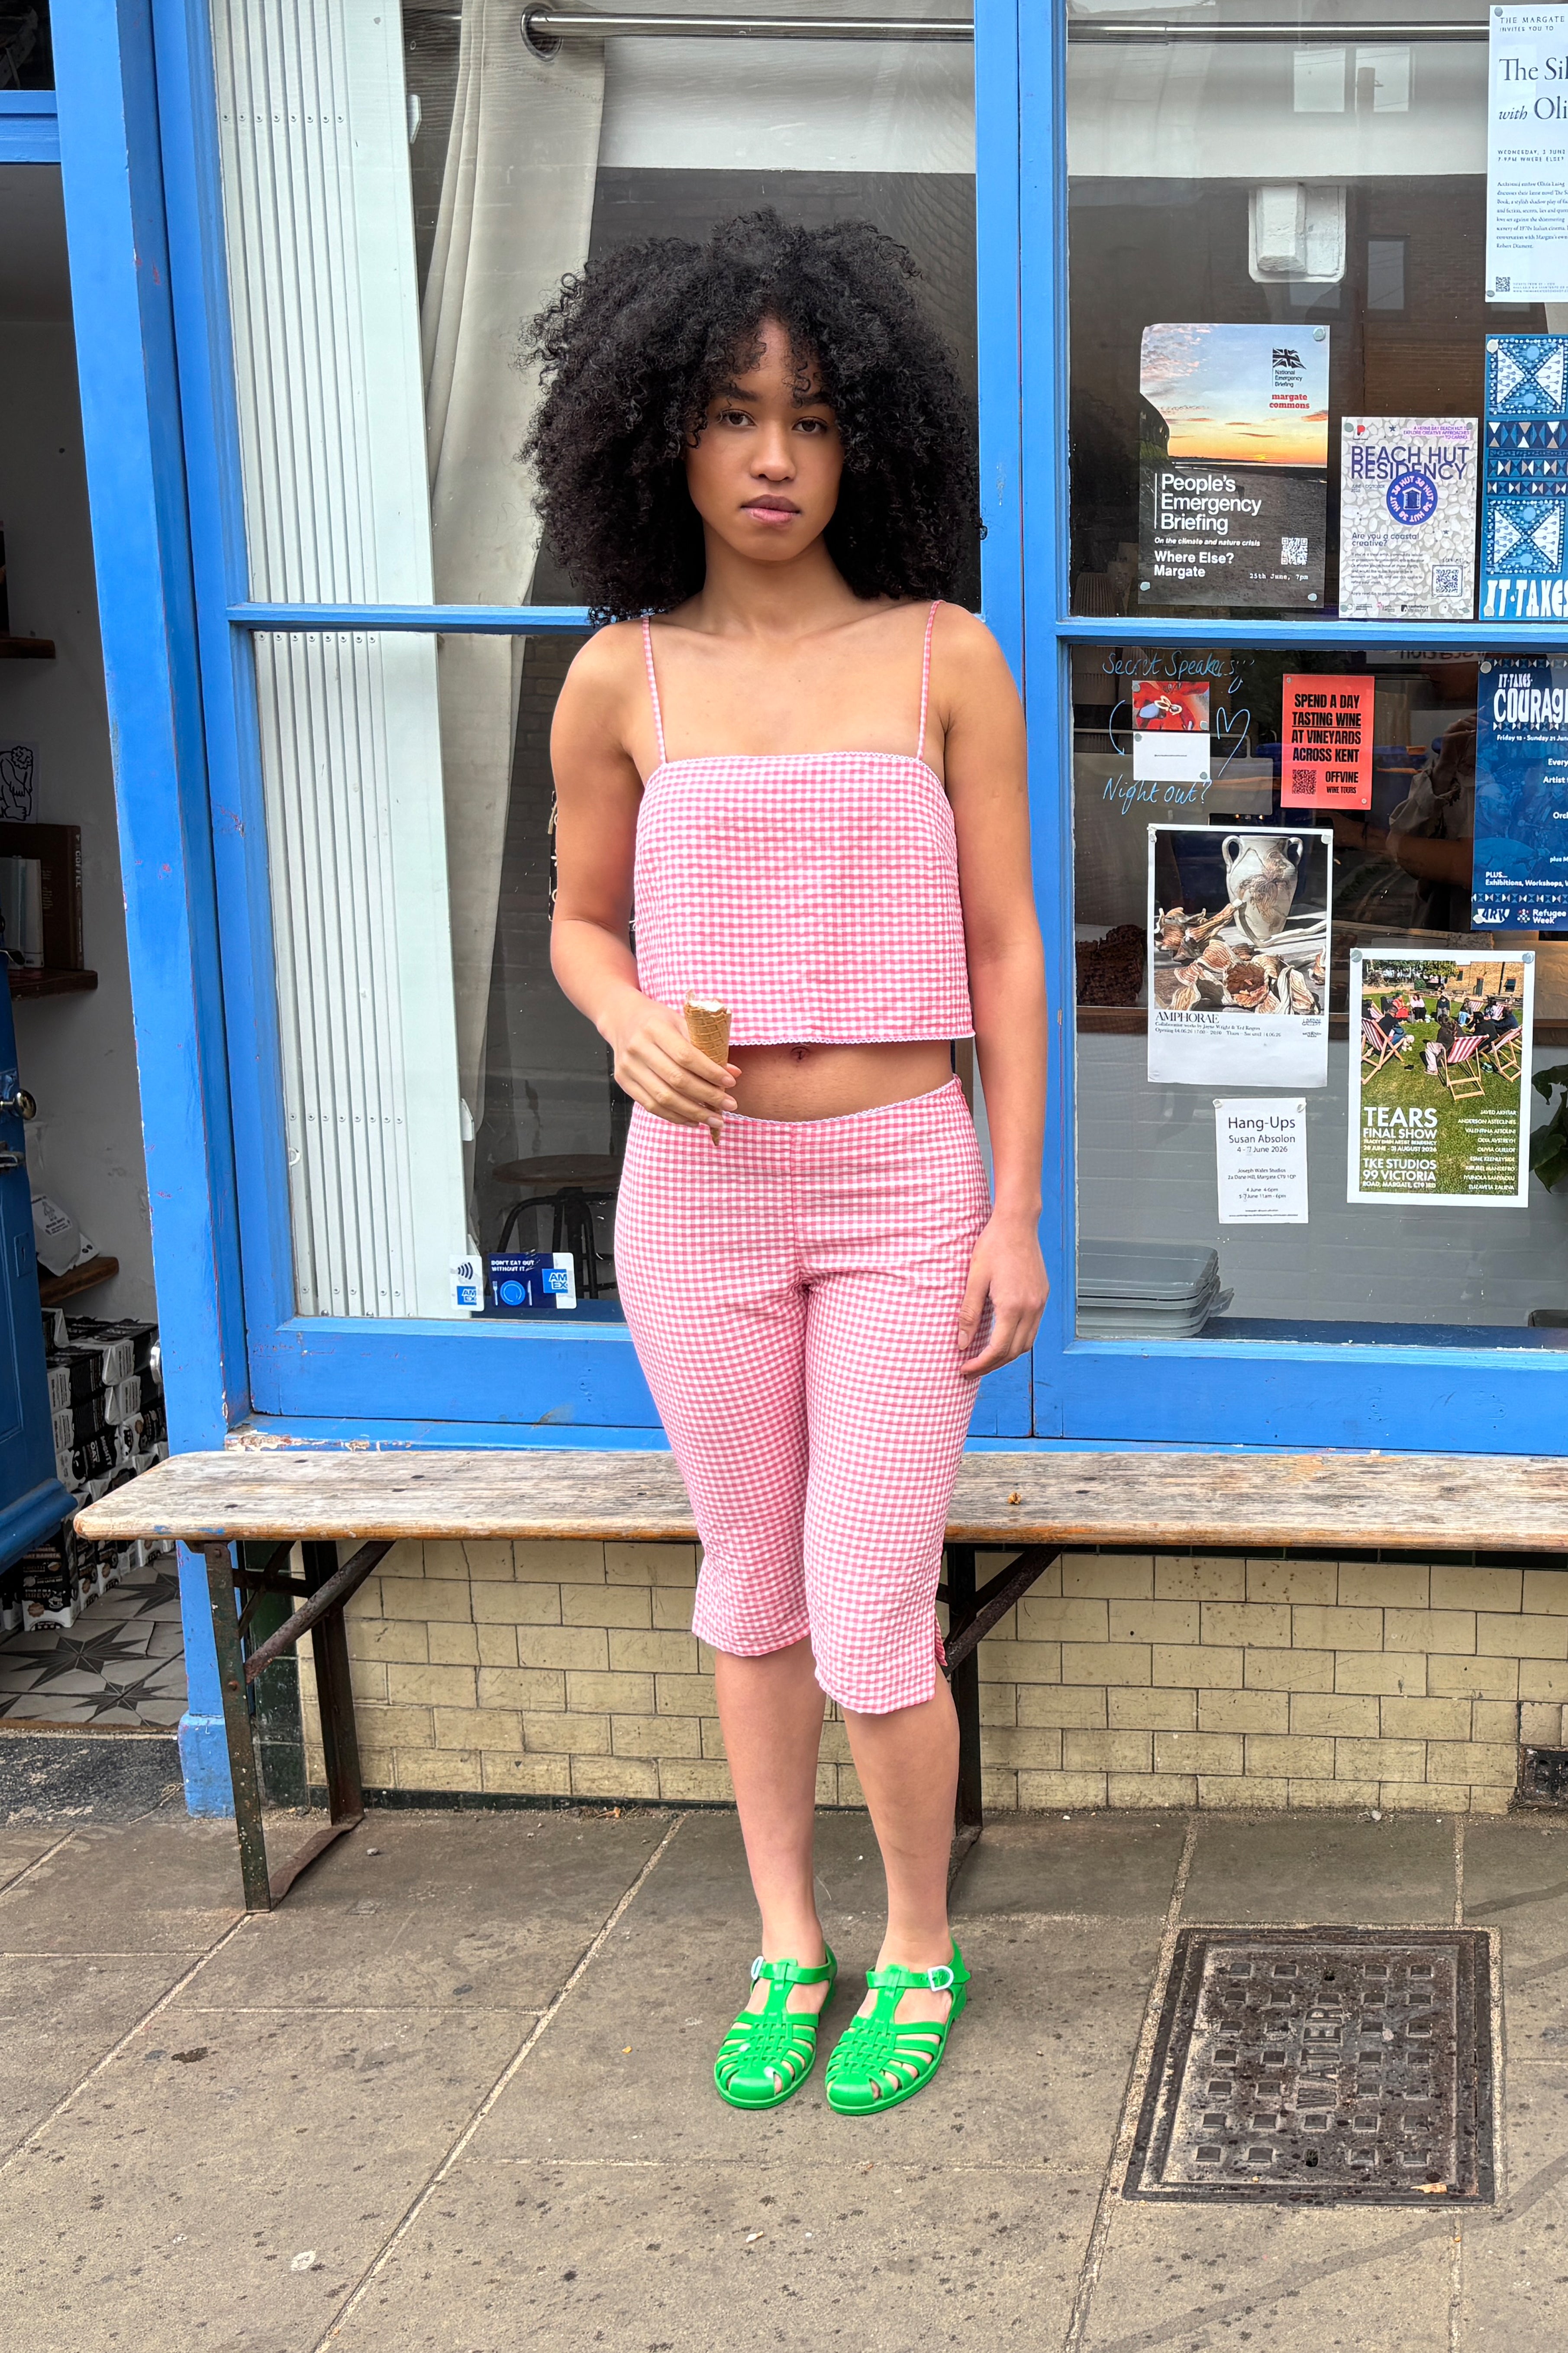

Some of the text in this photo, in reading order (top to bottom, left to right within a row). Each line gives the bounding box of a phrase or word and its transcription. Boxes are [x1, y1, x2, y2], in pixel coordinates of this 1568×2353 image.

[1499, 58, 1538, 81] The
[1499, 105, 1528, 120] with
[1352, 446, 1470, 464] BEACH HUT
[1351, 462, 1467, 480] RESIDENCY
[1162, 473, 1236, 495] People's
[1399, 476, 1414, 487] HUT
[1423, 485, 1434, 501] HUT
[1161, 493, 1262, 516] Emergency
[1390, 496, 1400, 512] HUT
[1161, 513, 1228, 535] Briefing
[1410, 511, 1425, 522] HUT
[1154, 550, 1234, 564] Where Else?
[1154, 564, 1206, 580] Margate
[1103, 653, 1163, 675] Secret
[1295, 694, 1359, 708] SPEND A DAY
[1292, 711, 1361, 727] TASTING WINE
[1291, 730, 1361, 744] AT VINEYARDS
[1293, 747, 1359, 762] ACROSS KENT
[1325, 771, 1358, 783] OFFVINE
[1103, 774, 1160, 815] Night
[1533, 909, 1567, 918] Refugee
[1155, 1012, 1220, 1024] AMPHORAE
[1229, 1116, 1295, 1131] Hang-Ups
[1364, 1106, 1438, 1128] TEARS
[1229, 1134, 1295, 1143] Susan Absolon
[1363, 1127, 1437, 1139] FINAL SHOW
[1363, 1158, 1437, 1170] TKE STUDIOS
[1363, 1170, 1436, 1181] 99 VICTORIA
[1297, 2008, 1342, 2109] WATER
